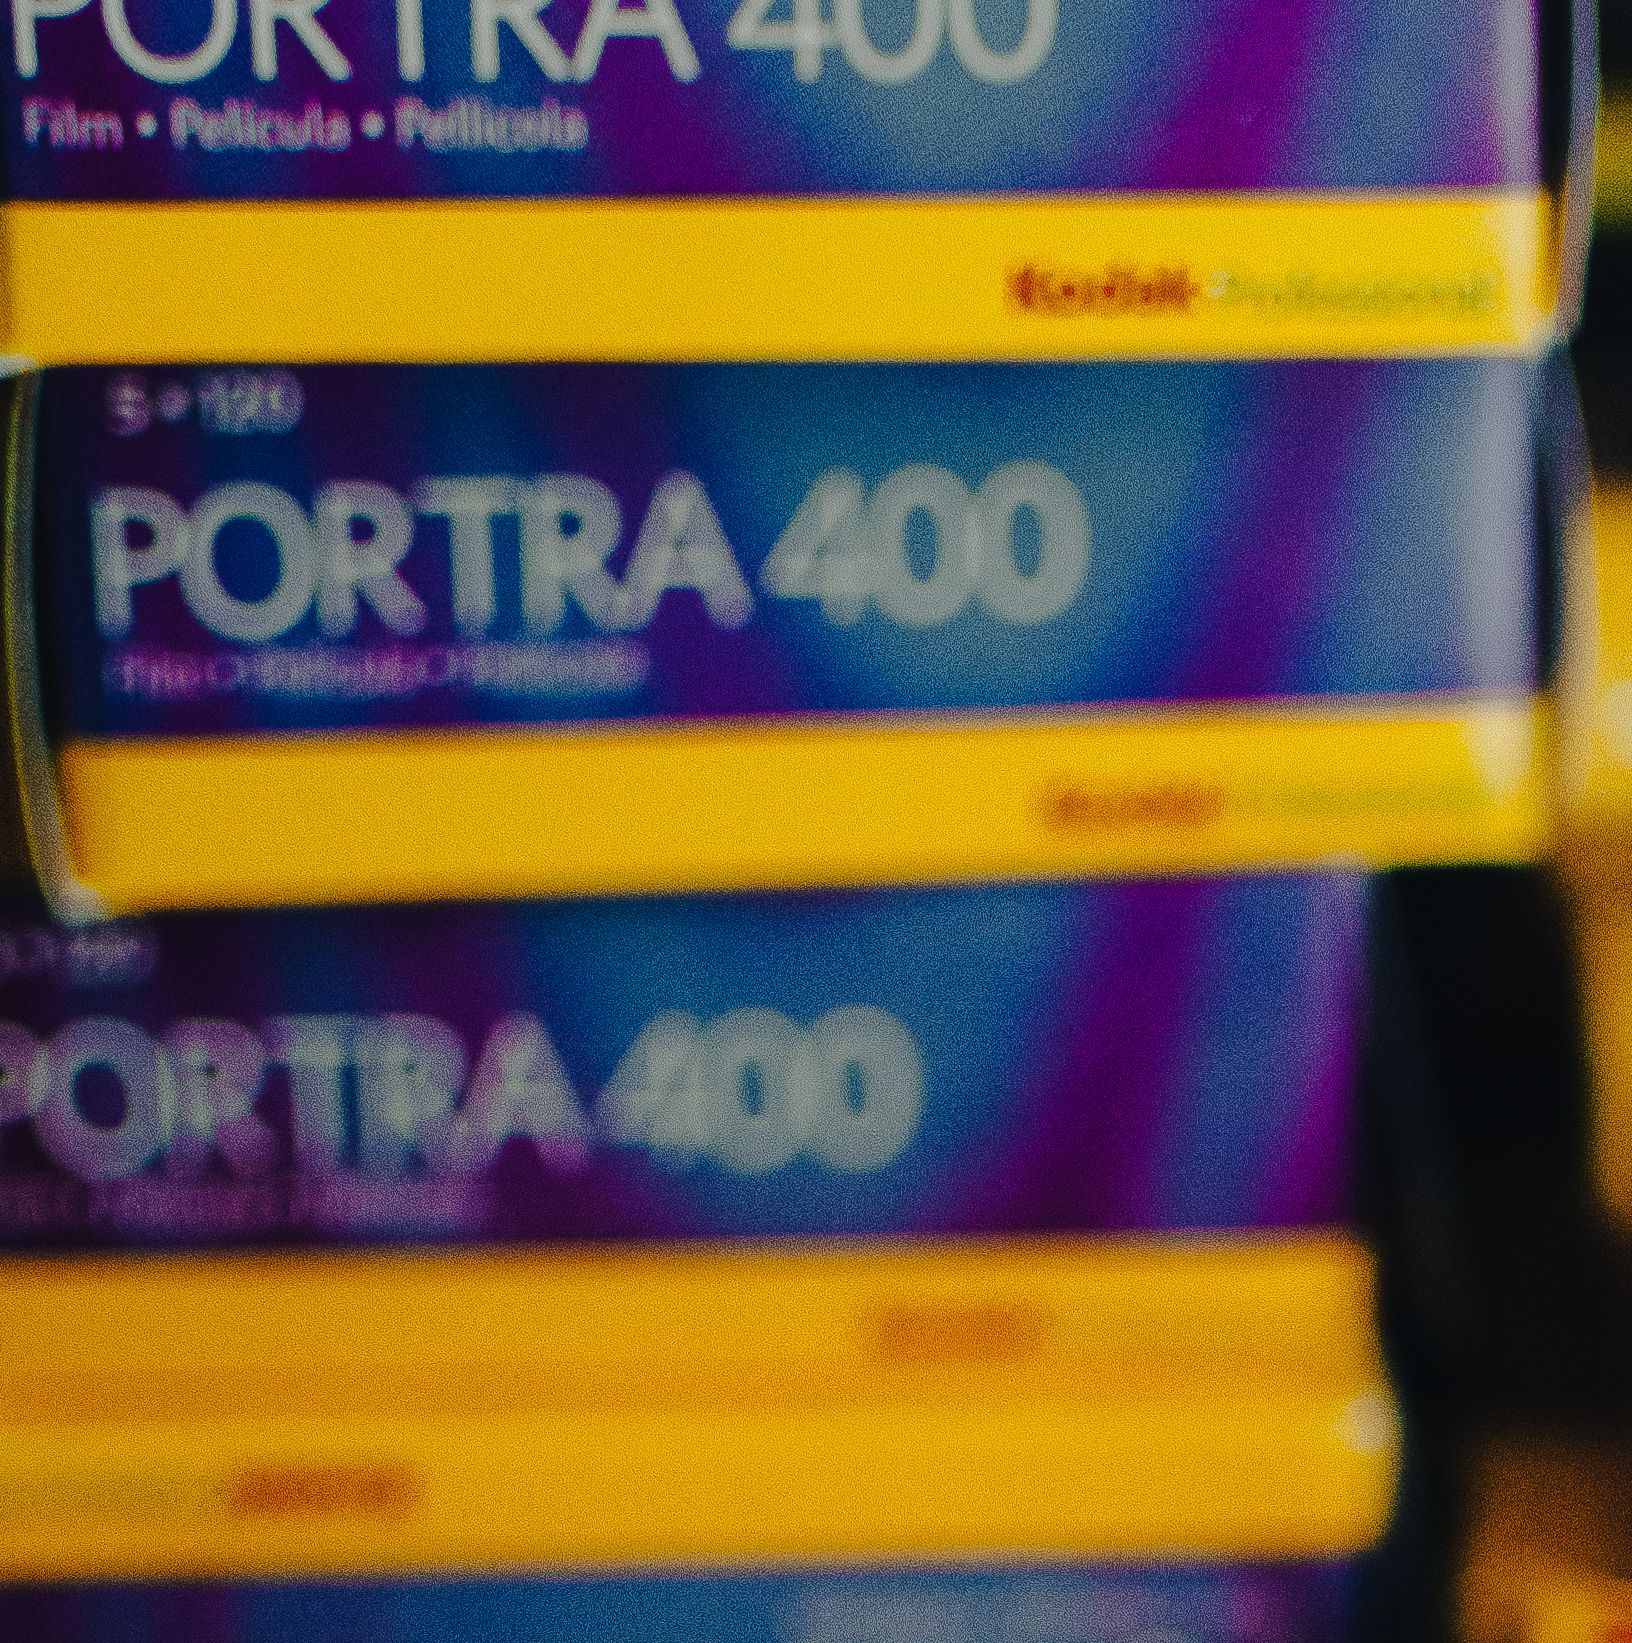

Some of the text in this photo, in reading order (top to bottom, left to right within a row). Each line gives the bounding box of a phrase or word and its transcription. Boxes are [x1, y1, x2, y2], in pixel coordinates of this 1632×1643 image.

[90, 458, 1094, 645] PORTRA 400
[600, 1005, 928, 1175] 400
